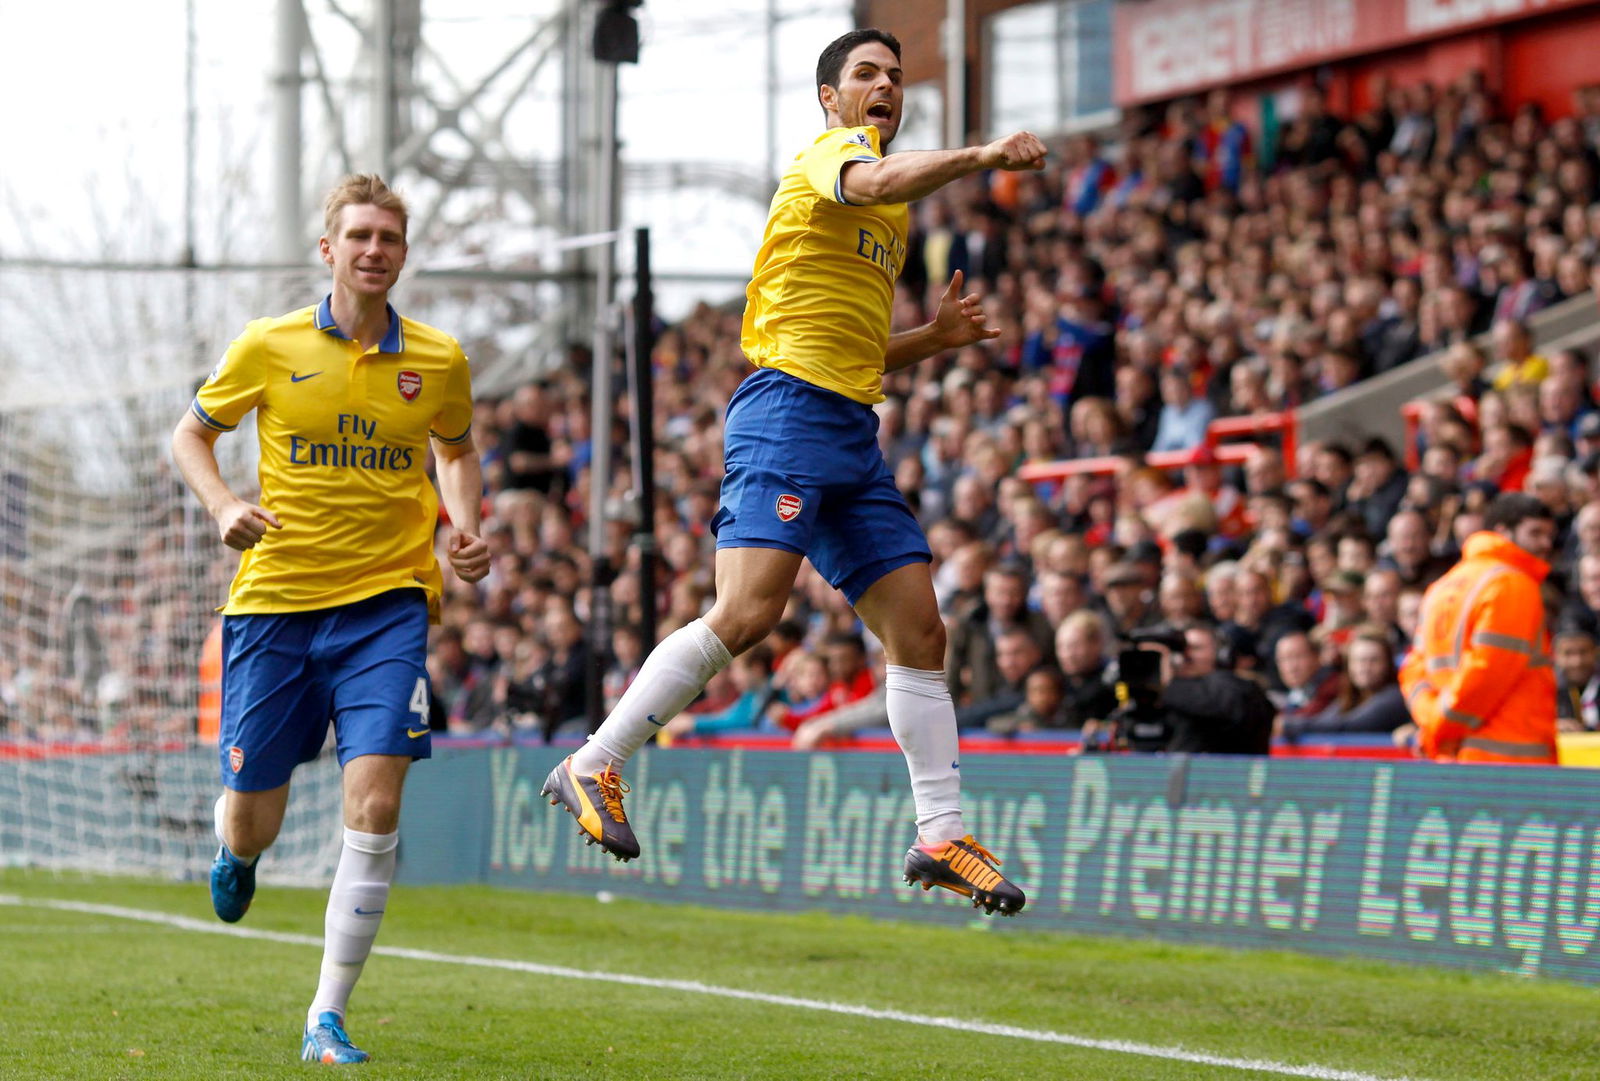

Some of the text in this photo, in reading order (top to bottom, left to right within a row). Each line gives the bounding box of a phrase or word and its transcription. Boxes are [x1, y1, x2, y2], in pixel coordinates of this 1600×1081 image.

[338, 414, 376, 440] Fly
[289, 435, 414, 470] Emirates
[409, 677, 430, 725] 4
[703, 747, 785, 893] the
[1059, 759, 1342, 931] Premier
[938, 844, 1004, 892] PUMA
